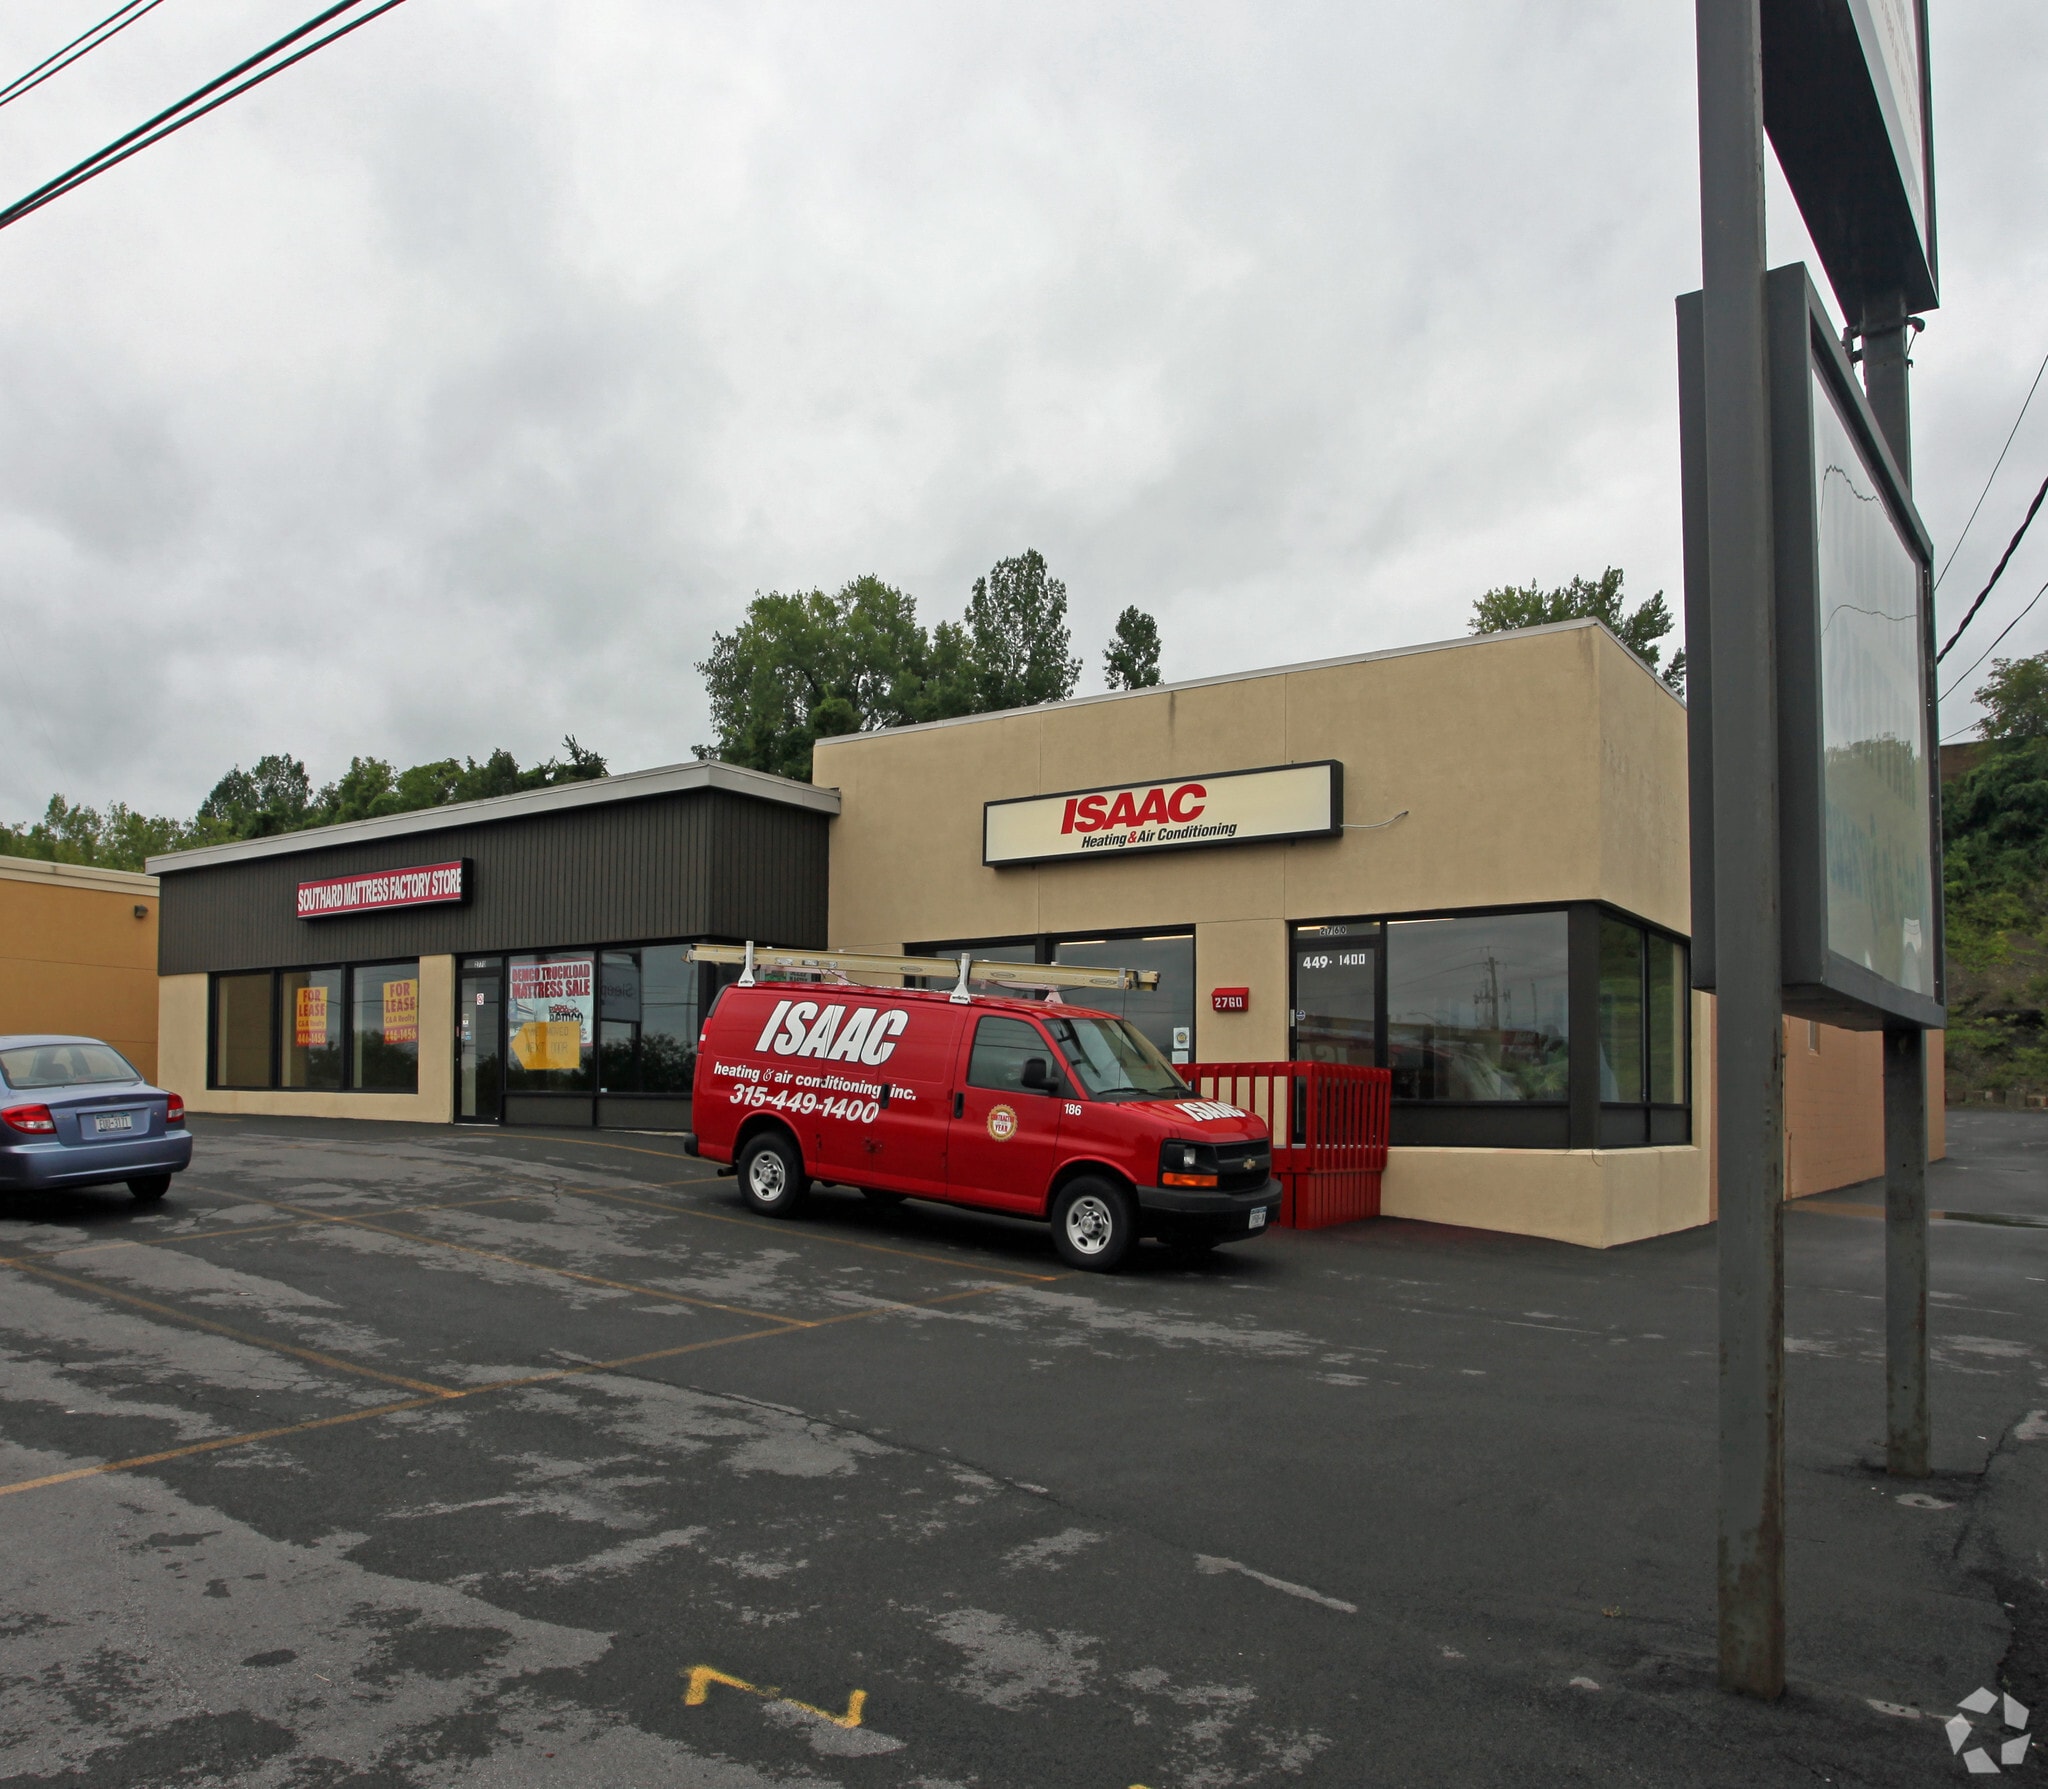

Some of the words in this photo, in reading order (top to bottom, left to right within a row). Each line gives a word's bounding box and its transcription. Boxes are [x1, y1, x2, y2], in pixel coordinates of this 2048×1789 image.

[1060, 783, 1207, 835] ISAAC
[1158, 822, 1237, 842] Conditioning
[298, 884, 342, 911] SOUTHARD
[343, 877, 389, 905] MATTRESS
[390, 872, 430, 900] FACTORY
[432, 868, 462, 895] STORE
[1319, 925, 1347, 936] 2760
[1339, 953, 1366, 966] 1400
[542, 964, 590, 979] TRUCKLOAD
[303, 989, 321, 1002] FOR
[390, 983, 411, 998] FOR
[511, 980, 564, 999] MATTRESS
[566, 979, 590, 997] SALE
[298, 1003, 326, 1017] LEASE
[385, 996, 416, 1013] LEASE
[1215, 996, 1243, 1008] 2760
[755, 999, 910, 1067] ISAAC
[713, 1061, 761, 1083] heating
[762, 1068, 775, 1082] &
[774, 1070, 795, 1085] air
[795, 1074, 882, 1098] conditioning
[889, 1083, 917, 1101] inc.
[729, 1083, 880, 1124] 315-449-1400
[1064, 1103, 1082, 1116] 186
[1174, 1101, 1247, 1122] ISAAC
